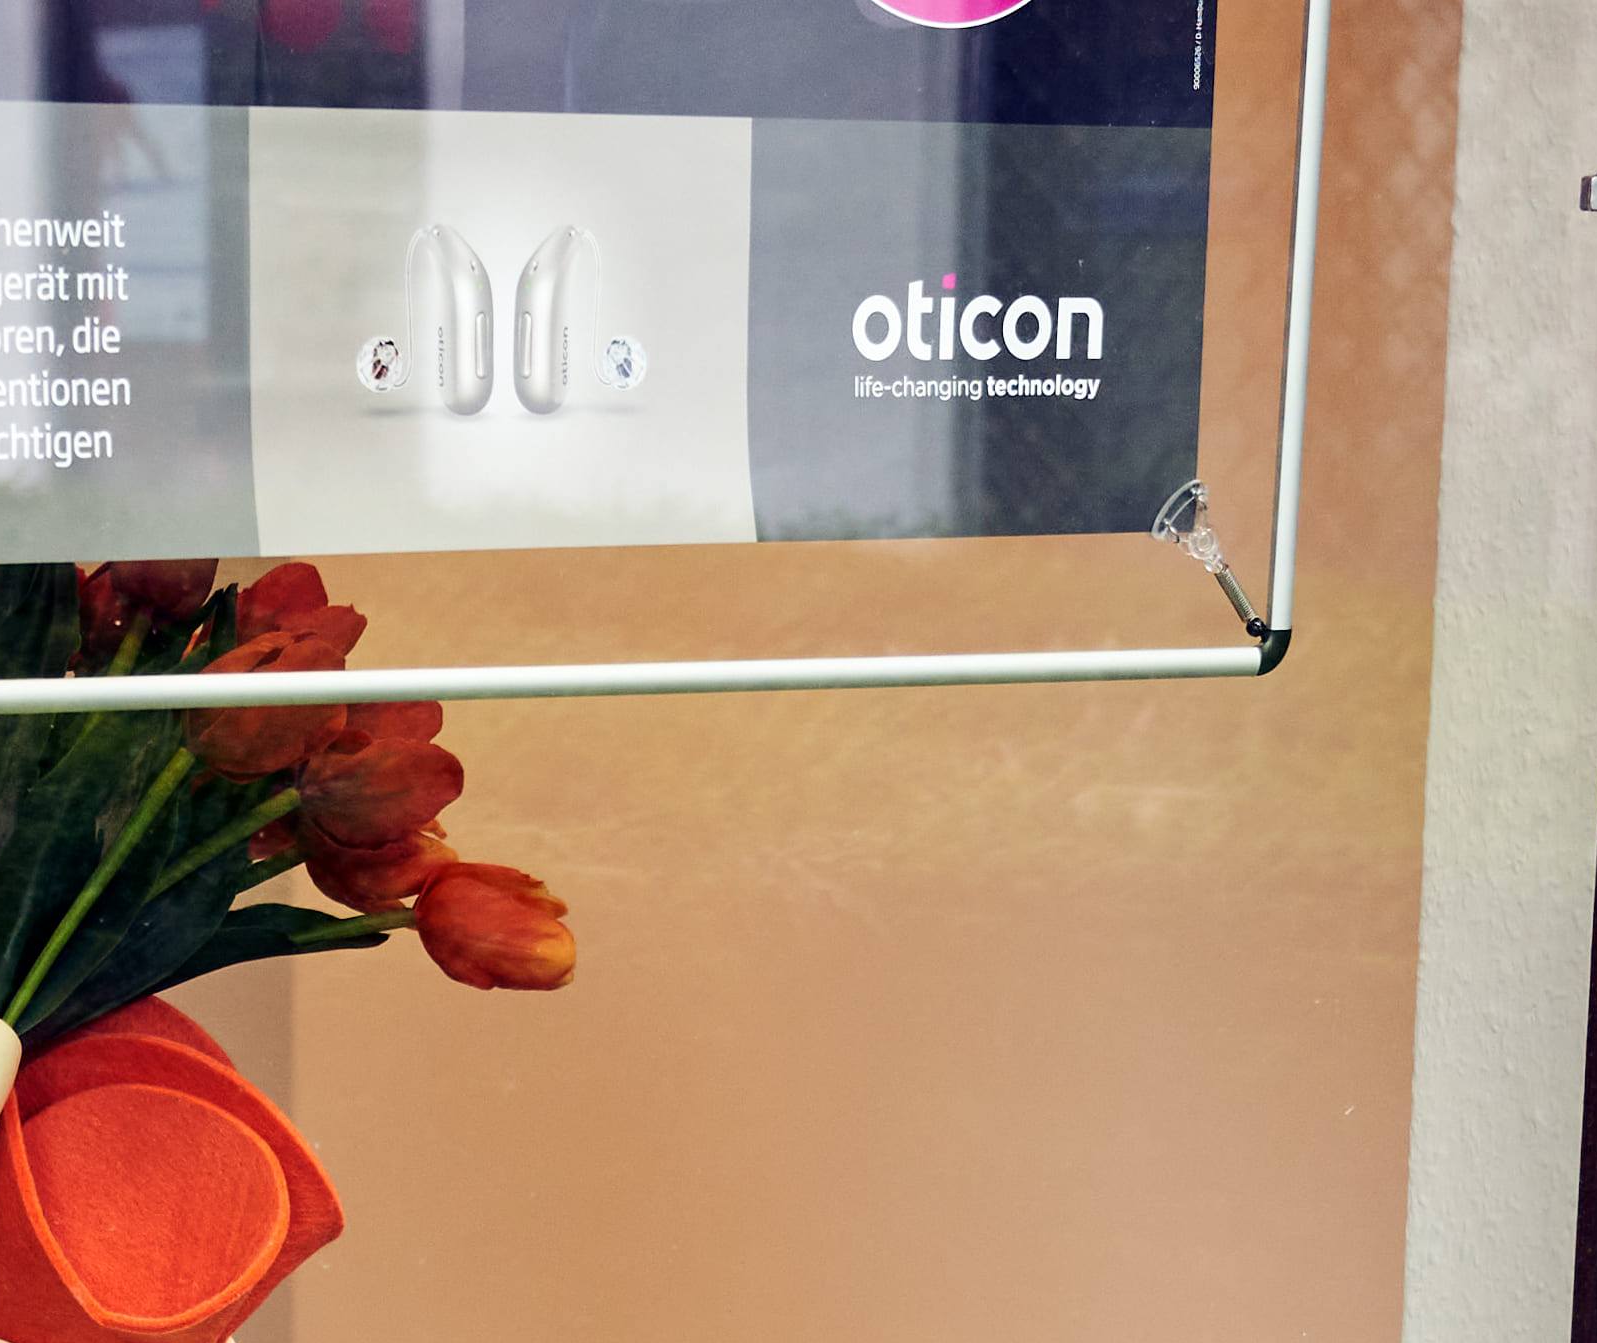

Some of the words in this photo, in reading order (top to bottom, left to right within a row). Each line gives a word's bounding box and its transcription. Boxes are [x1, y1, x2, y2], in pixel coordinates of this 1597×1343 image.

[77, 264, 129, 301] mit
[72, 317, 121, 354] die
[852, 273, 1103, 362] oticon
[854, 375, 983, 401] life-changing
[986, 374, 1101, 401] technology
